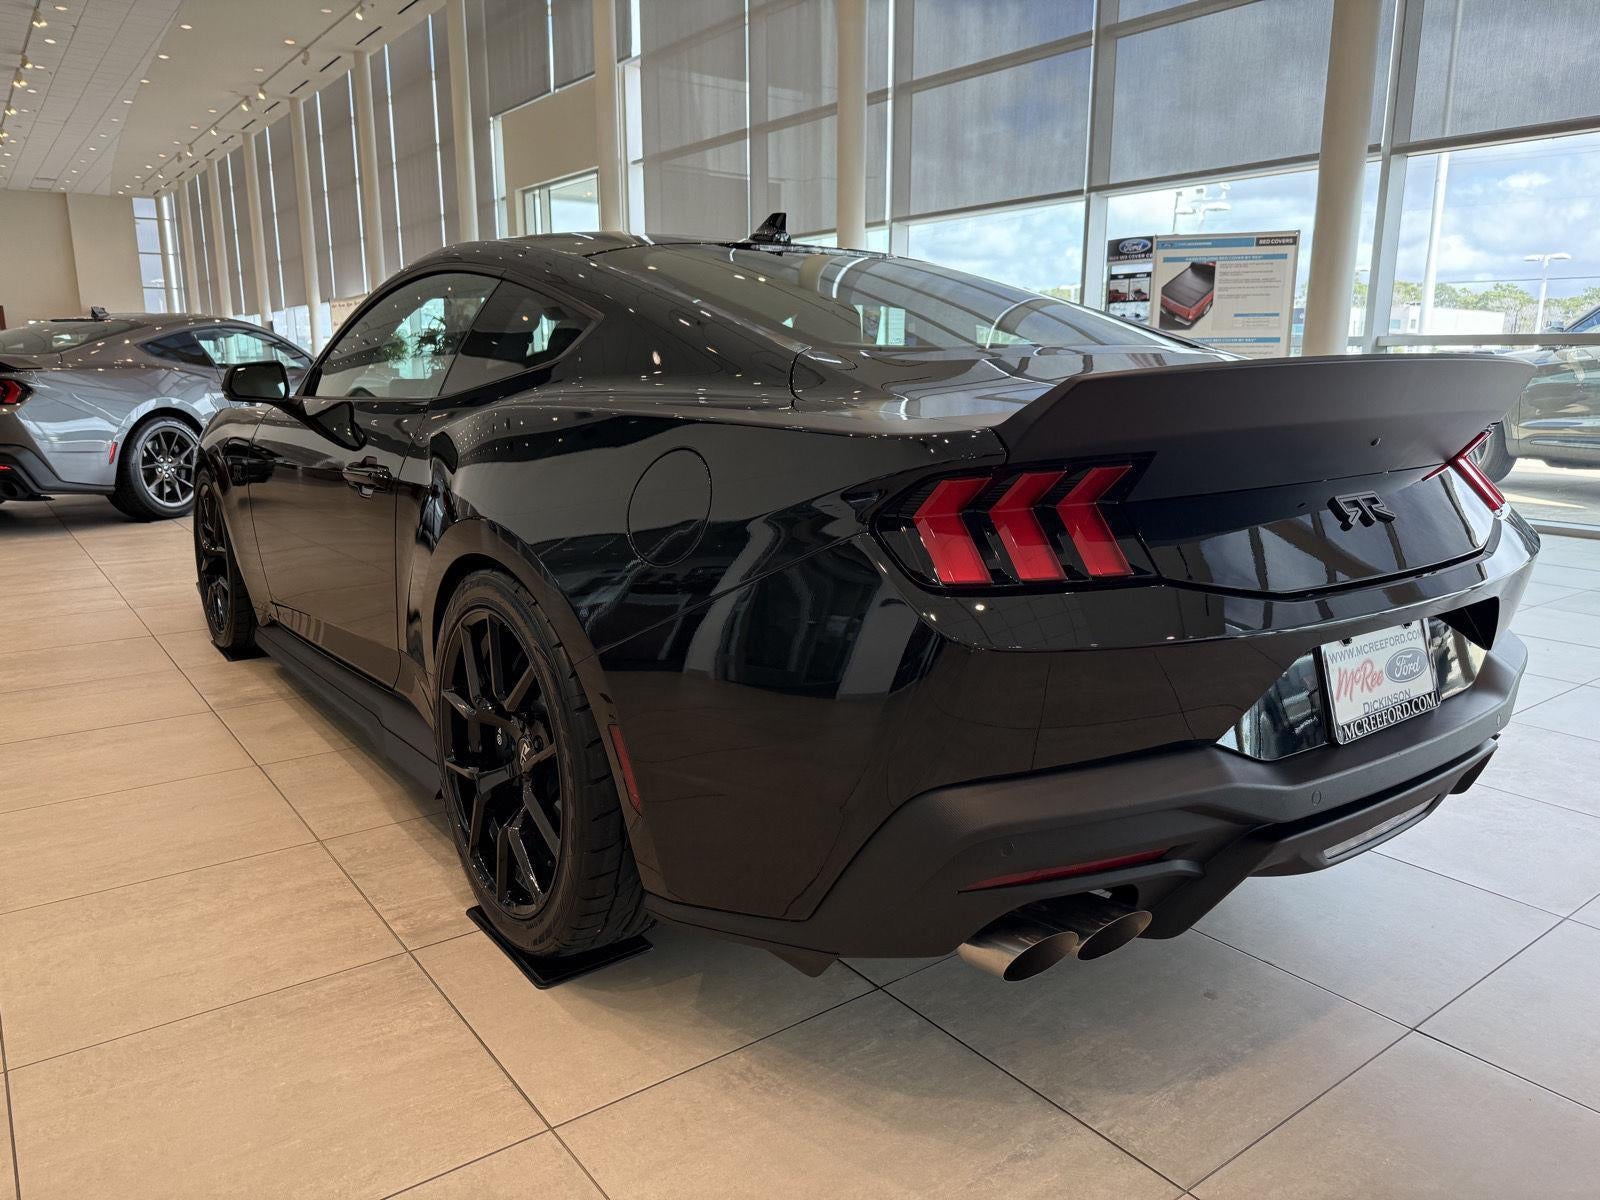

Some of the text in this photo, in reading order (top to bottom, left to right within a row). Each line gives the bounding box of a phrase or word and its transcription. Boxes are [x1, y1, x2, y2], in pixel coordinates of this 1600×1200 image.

[1394, 653, 1421, 678] Ford
[1363, 689, 1411, 715] DICKINSON
[1343, 691, 1438, 741] MCREEFORD.COM
